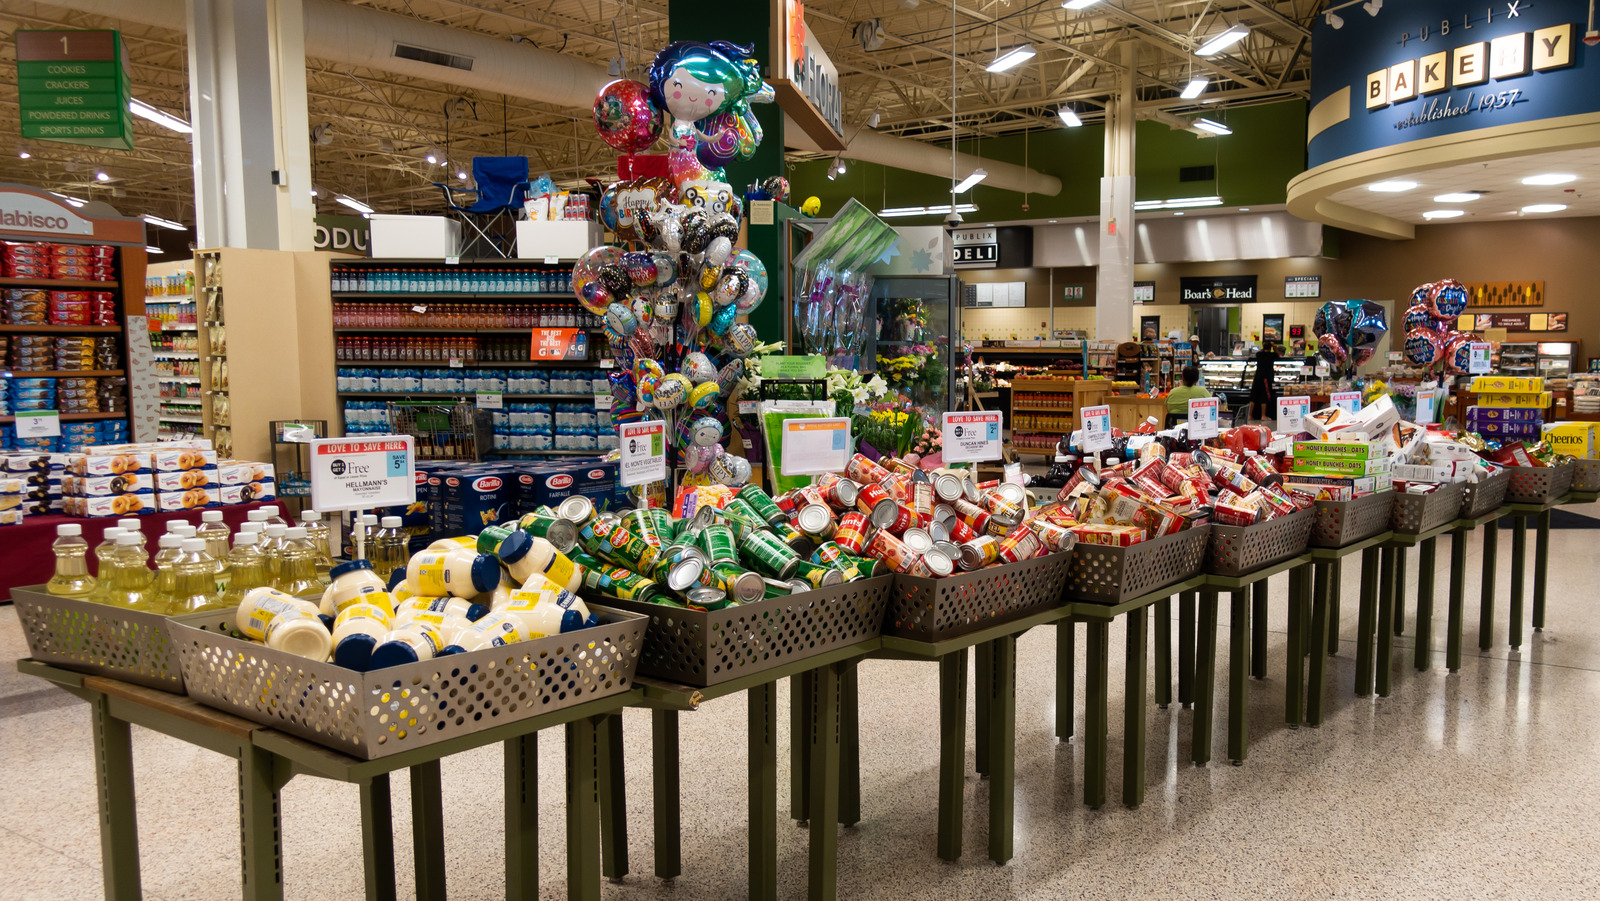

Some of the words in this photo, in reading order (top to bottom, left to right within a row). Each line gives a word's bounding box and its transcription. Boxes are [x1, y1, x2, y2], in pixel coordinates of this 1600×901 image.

[1401, 1, 1519, 47] PUBLIX
[60, 36, 68, 55] 1
[47, 66, 86, 74] COOKIES
[1370, 34, 1562, 99] BAKERY
[45, 80, 90, 89] CRACKERS
[54, 96, 84, 105] JUICES
[1395, 91, 1473, 130] established
[1478, 88, 1519, 111] 1957
[0, 208, 68, 230] abisco
[956, 232, 992, 240] PUBLIX
[954, 247, 992, 260] DELI
[1184, 288, 1212, 299] Boar's
[1226, 287, 1252, 298] Head
[964, 428, 976, 436] Free
[1545, 433, 1583, 444] Cheerios
[327, 444, 346, 453] LOVE
[350, 443, 360, 451] TO
[364, 442, 381, 451] SAVE
[385, 441, 404, 450] HERE.
[637, 442, 646, 452] Free
[348, 462, 370, 474] Free
[346, 479, 388, 488] HELLMANN'S
[479, 480, 500, 488] Barilla
[552, 477, 571, 485] Barilla
